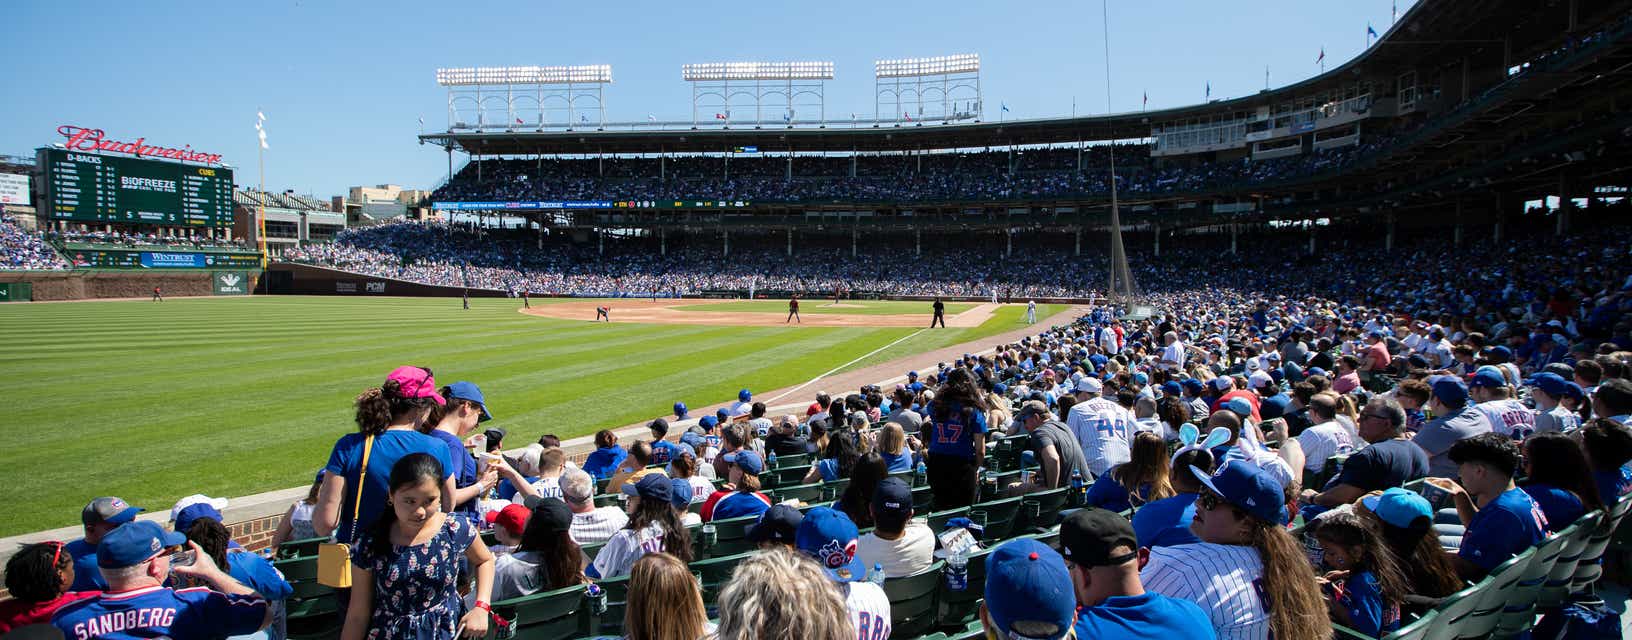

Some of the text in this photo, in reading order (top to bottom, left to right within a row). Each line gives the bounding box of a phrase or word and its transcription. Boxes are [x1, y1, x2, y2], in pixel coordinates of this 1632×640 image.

[56, 125, 223, 163] Budweiser
[66, 153, 102, 164] D-BACKS
[198, 168, 215, 176] CUBS
[936, 422, 963, 443] 17
[1096, 416, 1126, 438] 44
[74, 607, 176, 640] SANDBERG
